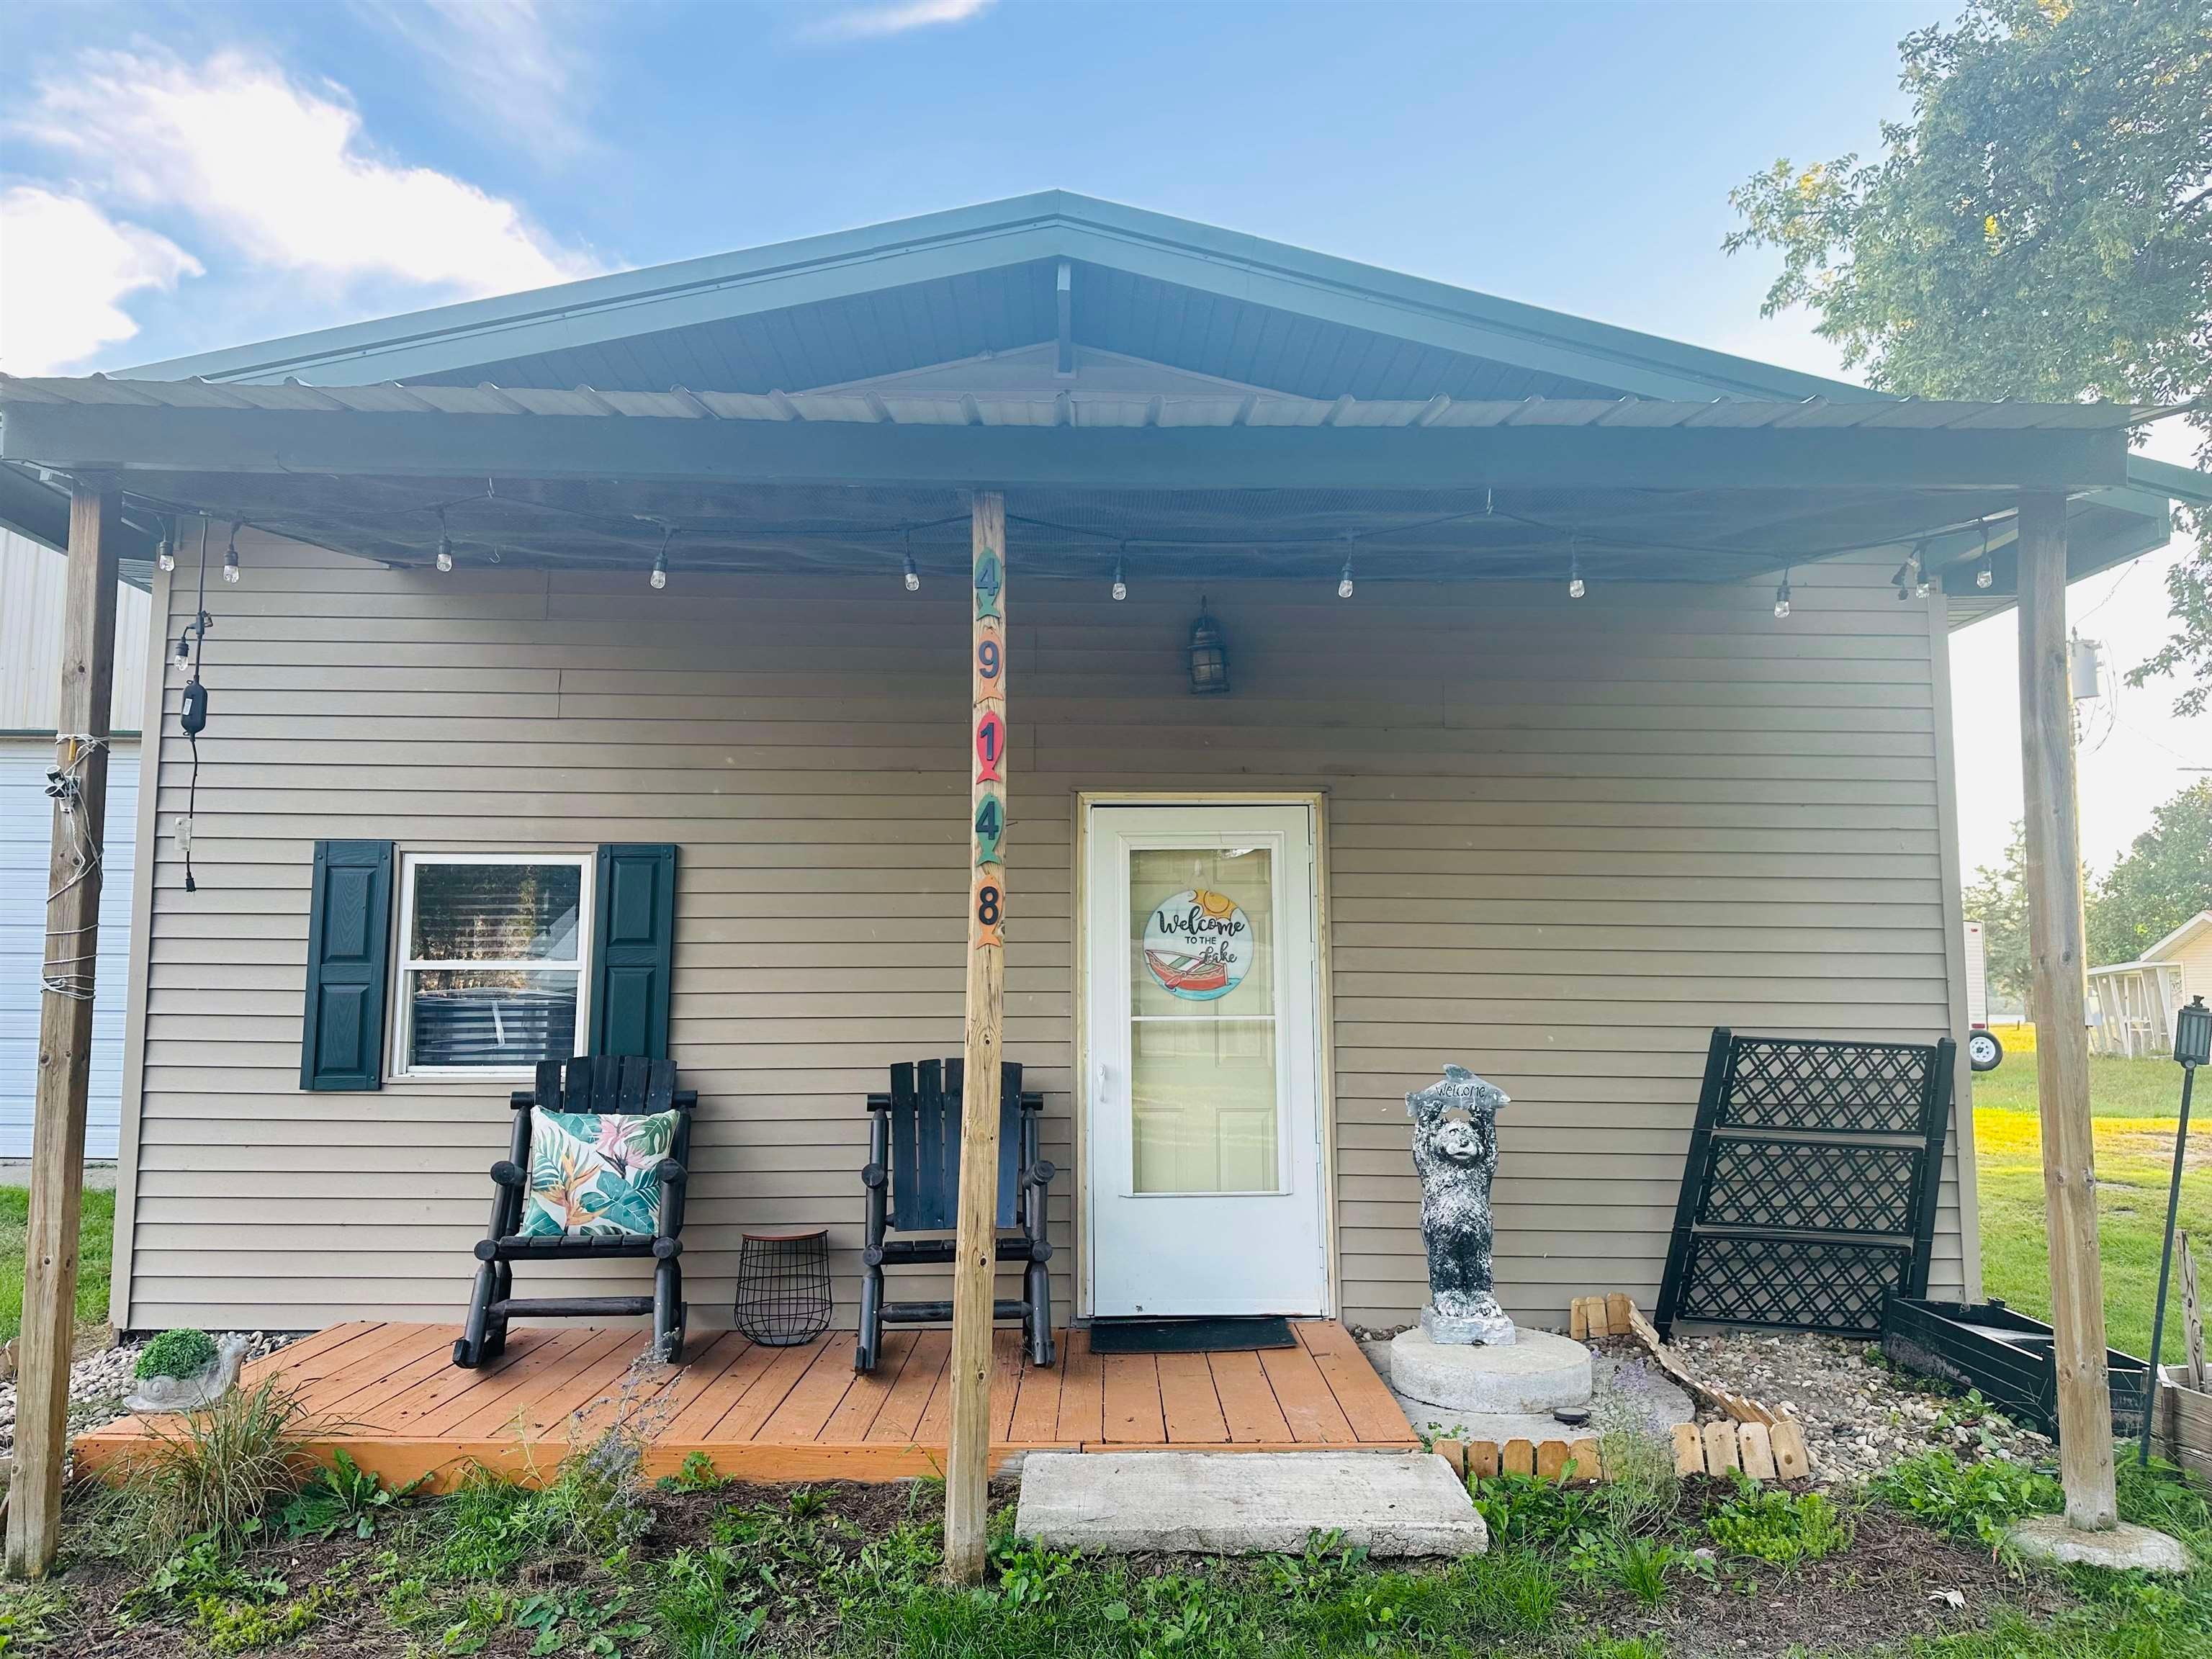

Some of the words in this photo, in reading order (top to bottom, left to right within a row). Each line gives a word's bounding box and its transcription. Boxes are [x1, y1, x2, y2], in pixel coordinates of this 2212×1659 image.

[1157, 905, 1246, 938] Welcome
[1186, 936, 1197, 945] TO
[1199, 936, 1216, 945] THE
[1199, 940, 1238, 964] Lake
